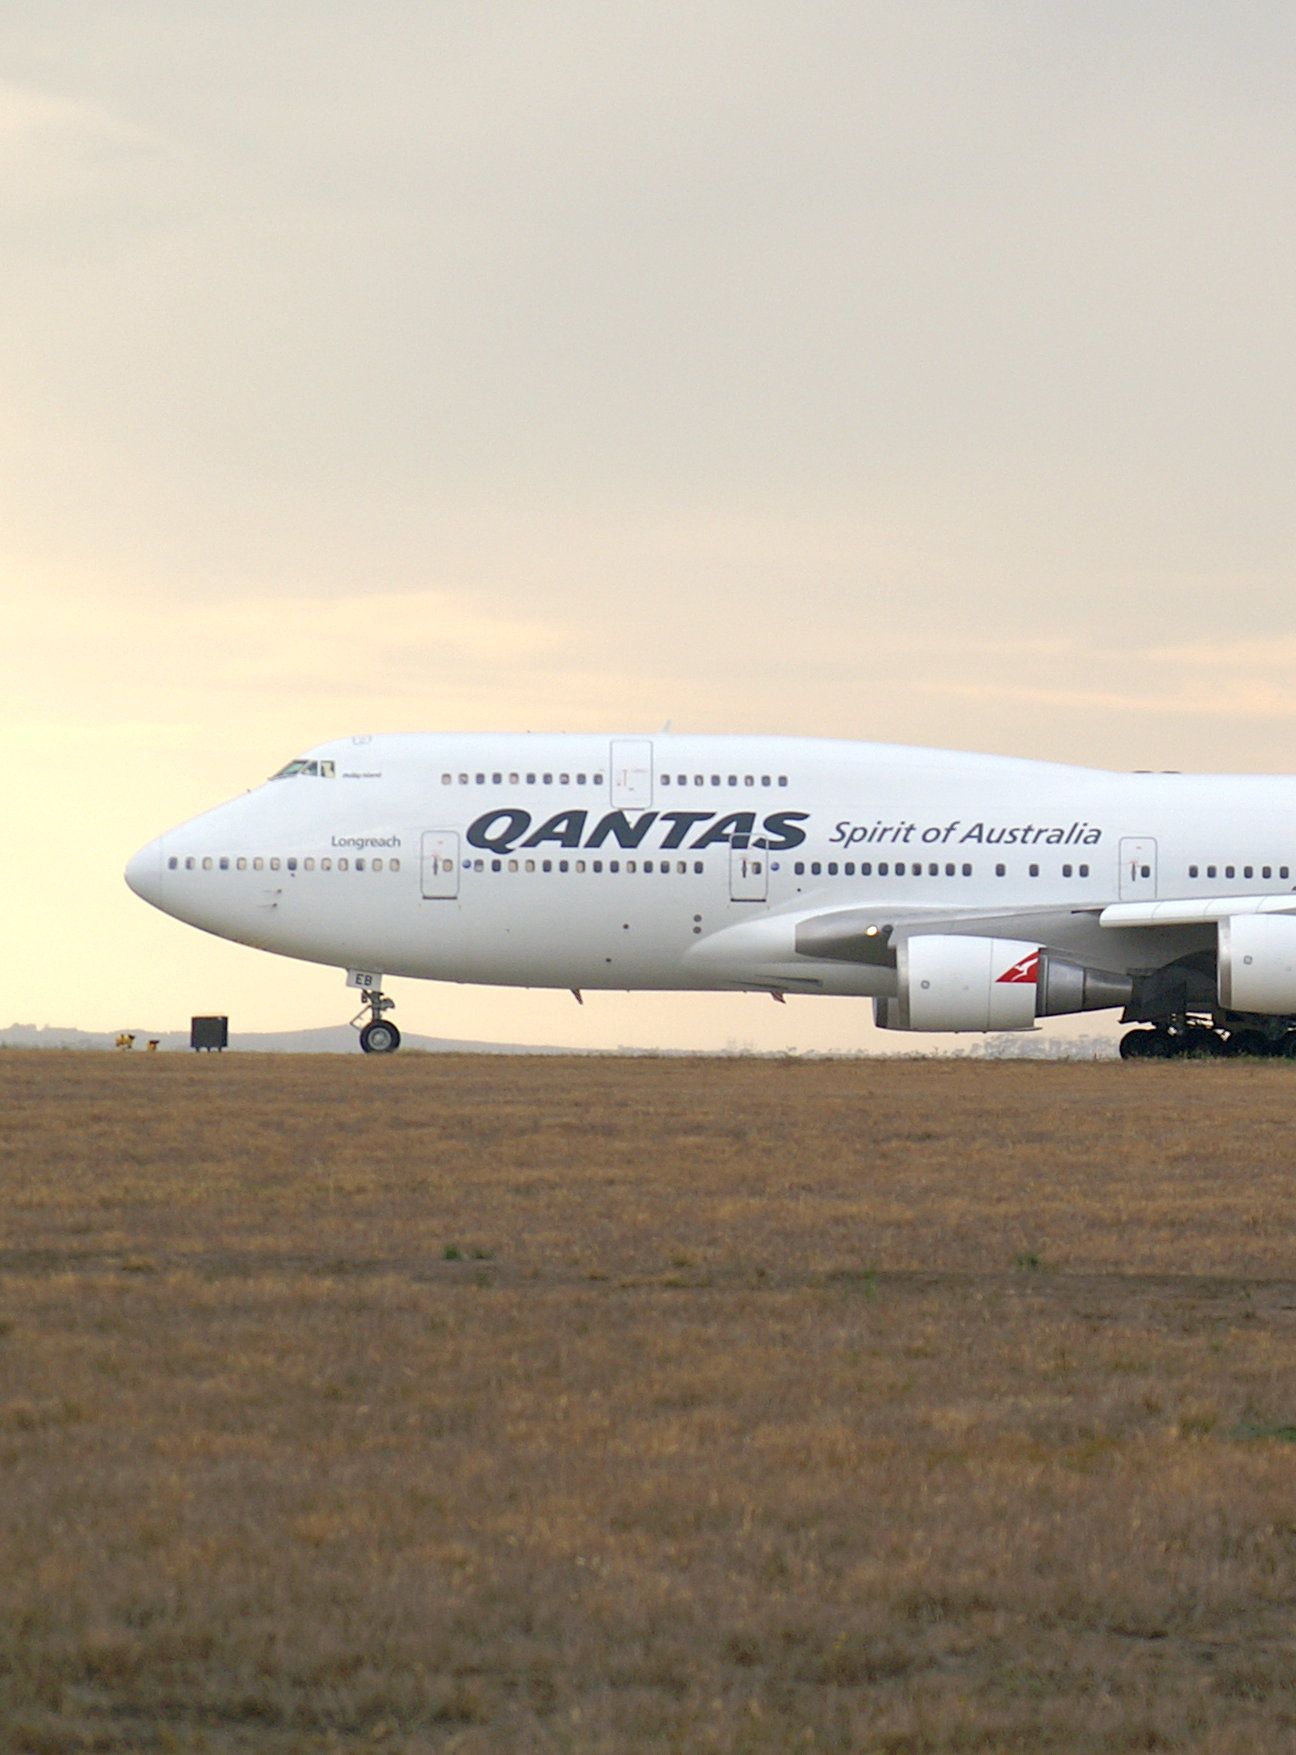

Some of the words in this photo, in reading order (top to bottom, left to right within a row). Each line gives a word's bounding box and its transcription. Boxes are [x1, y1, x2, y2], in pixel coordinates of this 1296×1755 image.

[466, 808, 810, 854] QANTAS
[829, 821, 916, 848] Spirit
[921, 821, 961, 843] of
[959, 822, 1102, 845] Australia
[331, 835, 401, 850] Longreach
[355, 973, 373, 986] EB
